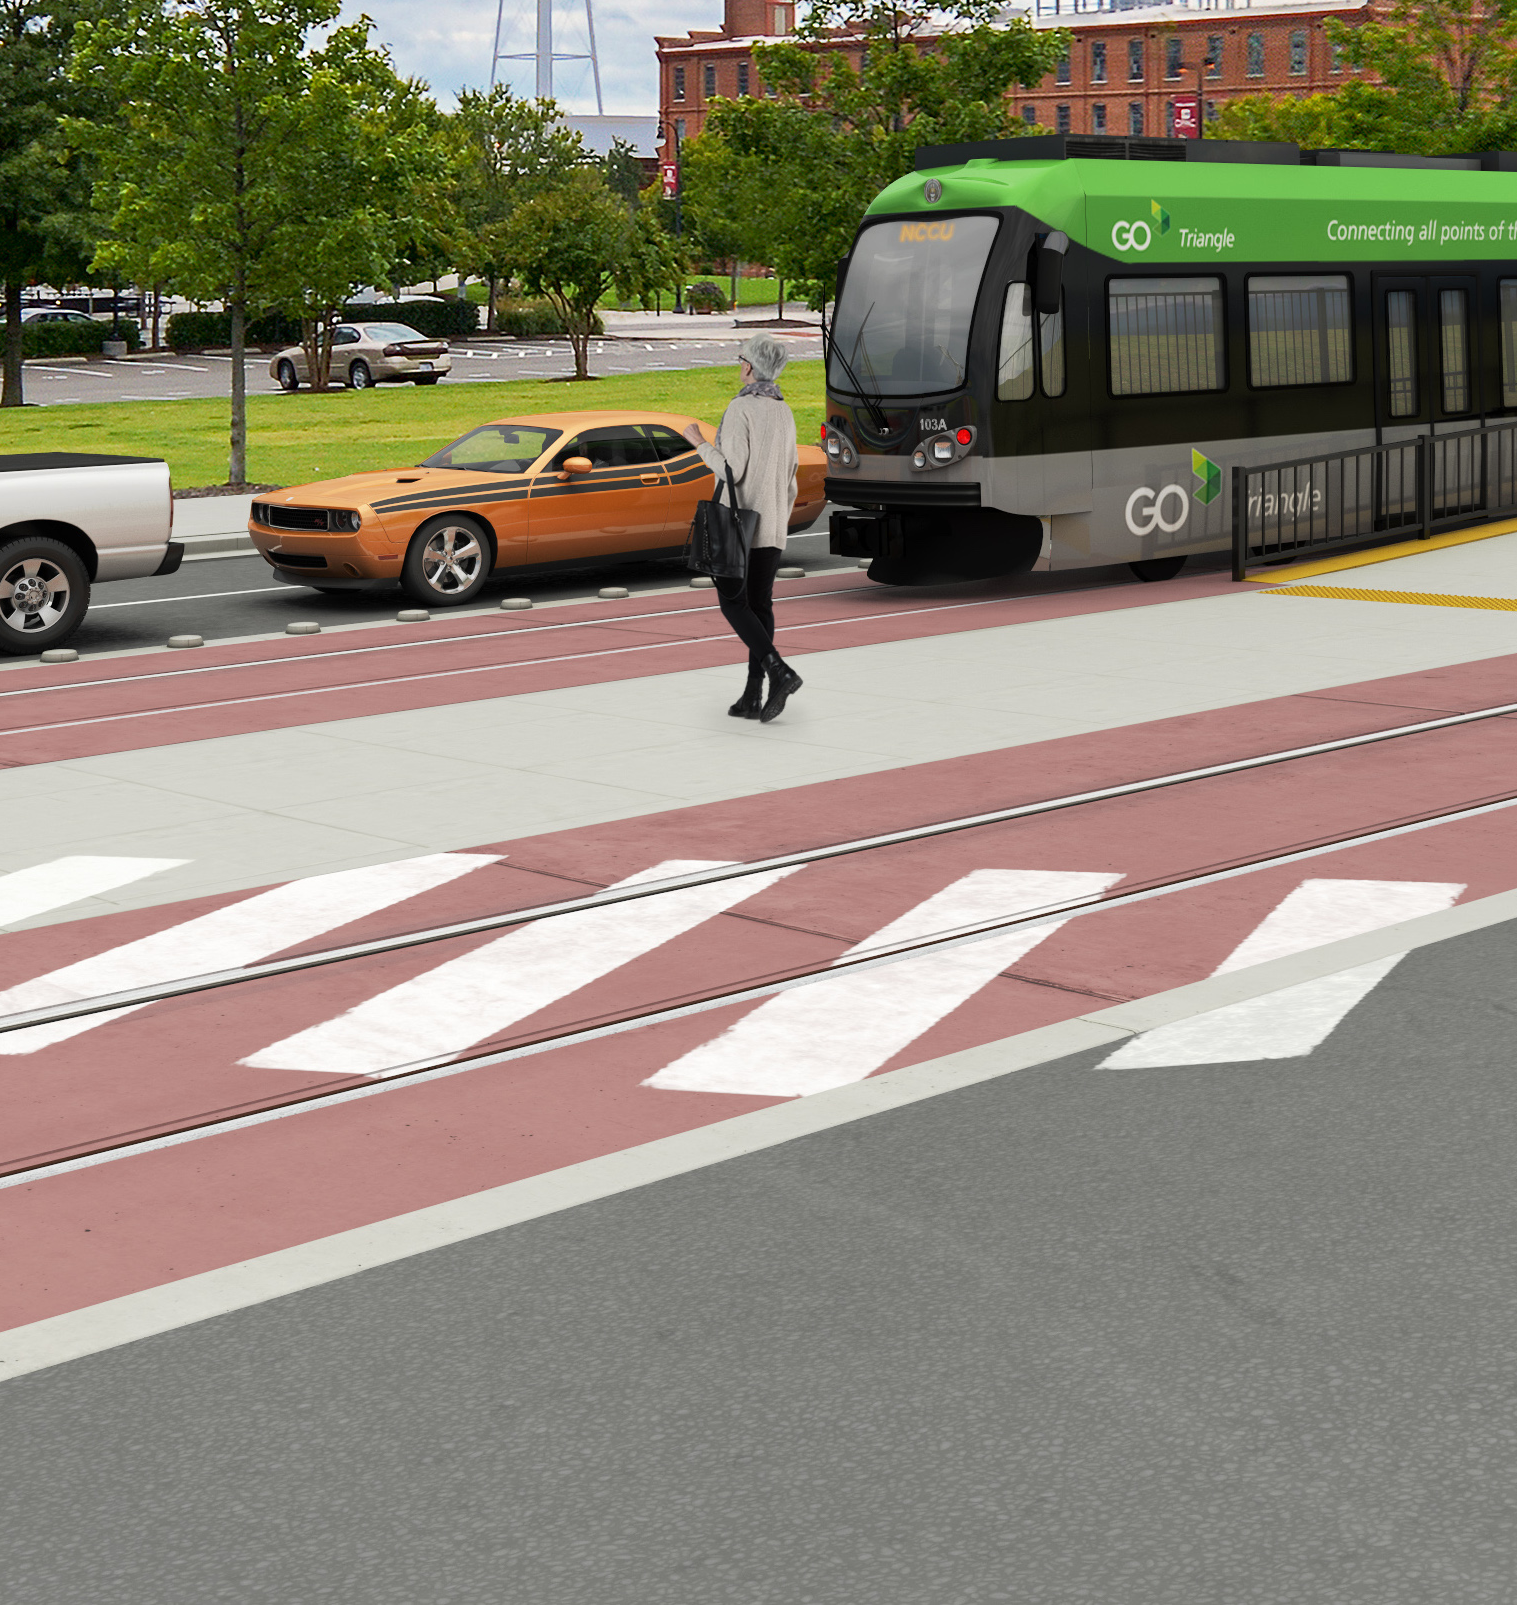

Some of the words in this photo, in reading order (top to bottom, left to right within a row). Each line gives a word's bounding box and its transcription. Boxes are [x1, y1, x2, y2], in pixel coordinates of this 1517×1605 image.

[899, 222, 955, 242] NCCU
[1111, 220, 1151, 251] GO
[1179, 227, 1235, 253] Triangle
[1327, 219, 1415, 246] Connecting
[1419, 219, 1436, 241] all
[1440, 220, 1485, 246] points
[1489, 219, 1505, 241] of
[920, 418, 947, 430] 103A
[1125, 483, 1189, 536] GO
[1247, 481, 1321, 521] riangle
